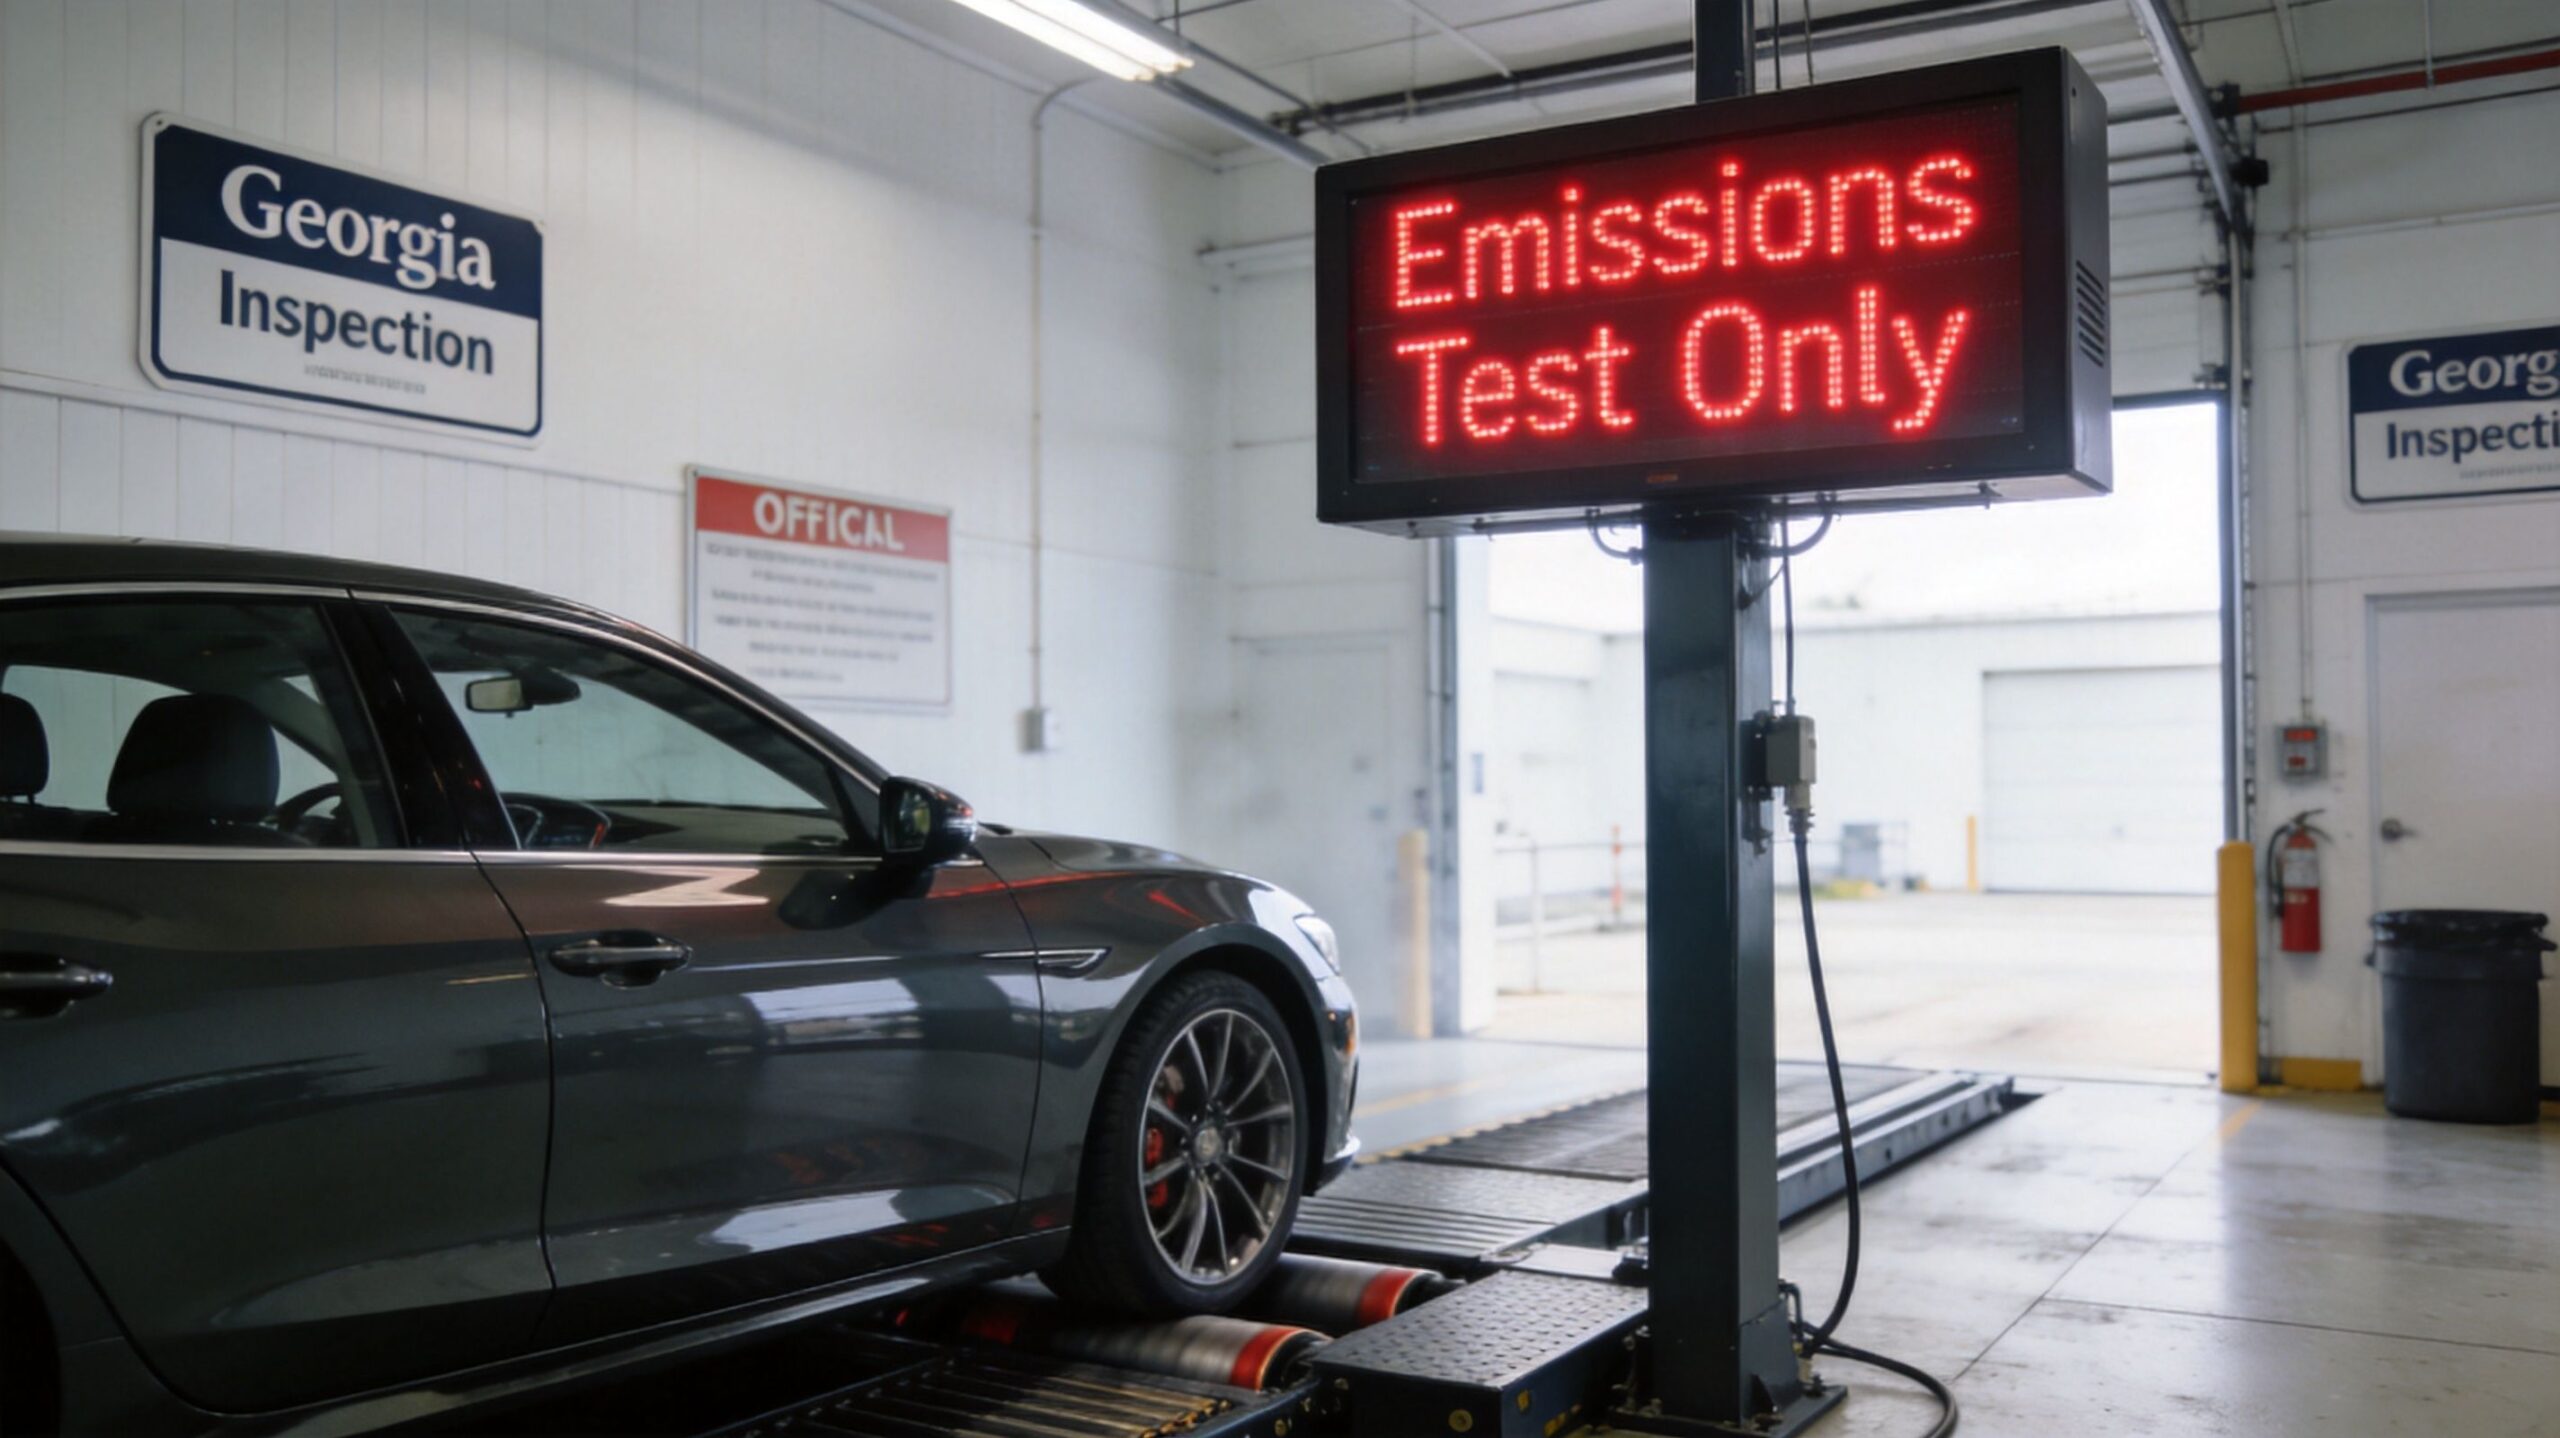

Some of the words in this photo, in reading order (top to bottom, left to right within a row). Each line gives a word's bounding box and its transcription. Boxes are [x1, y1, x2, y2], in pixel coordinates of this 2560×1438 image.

[220, 165, 496, 290] Georgia
[1395, 154, 1975, 307] Emissions
[220, 269, 493, 375] Inspection
[1395, 327, 1635, 446] Test
[1681, 286, 1971, 433] Only
[2389, 350, 2560, 396] Georg
[2387, 410, 2560, 464] Inspecti
[754, 491, 905, 551] OFFICAL
